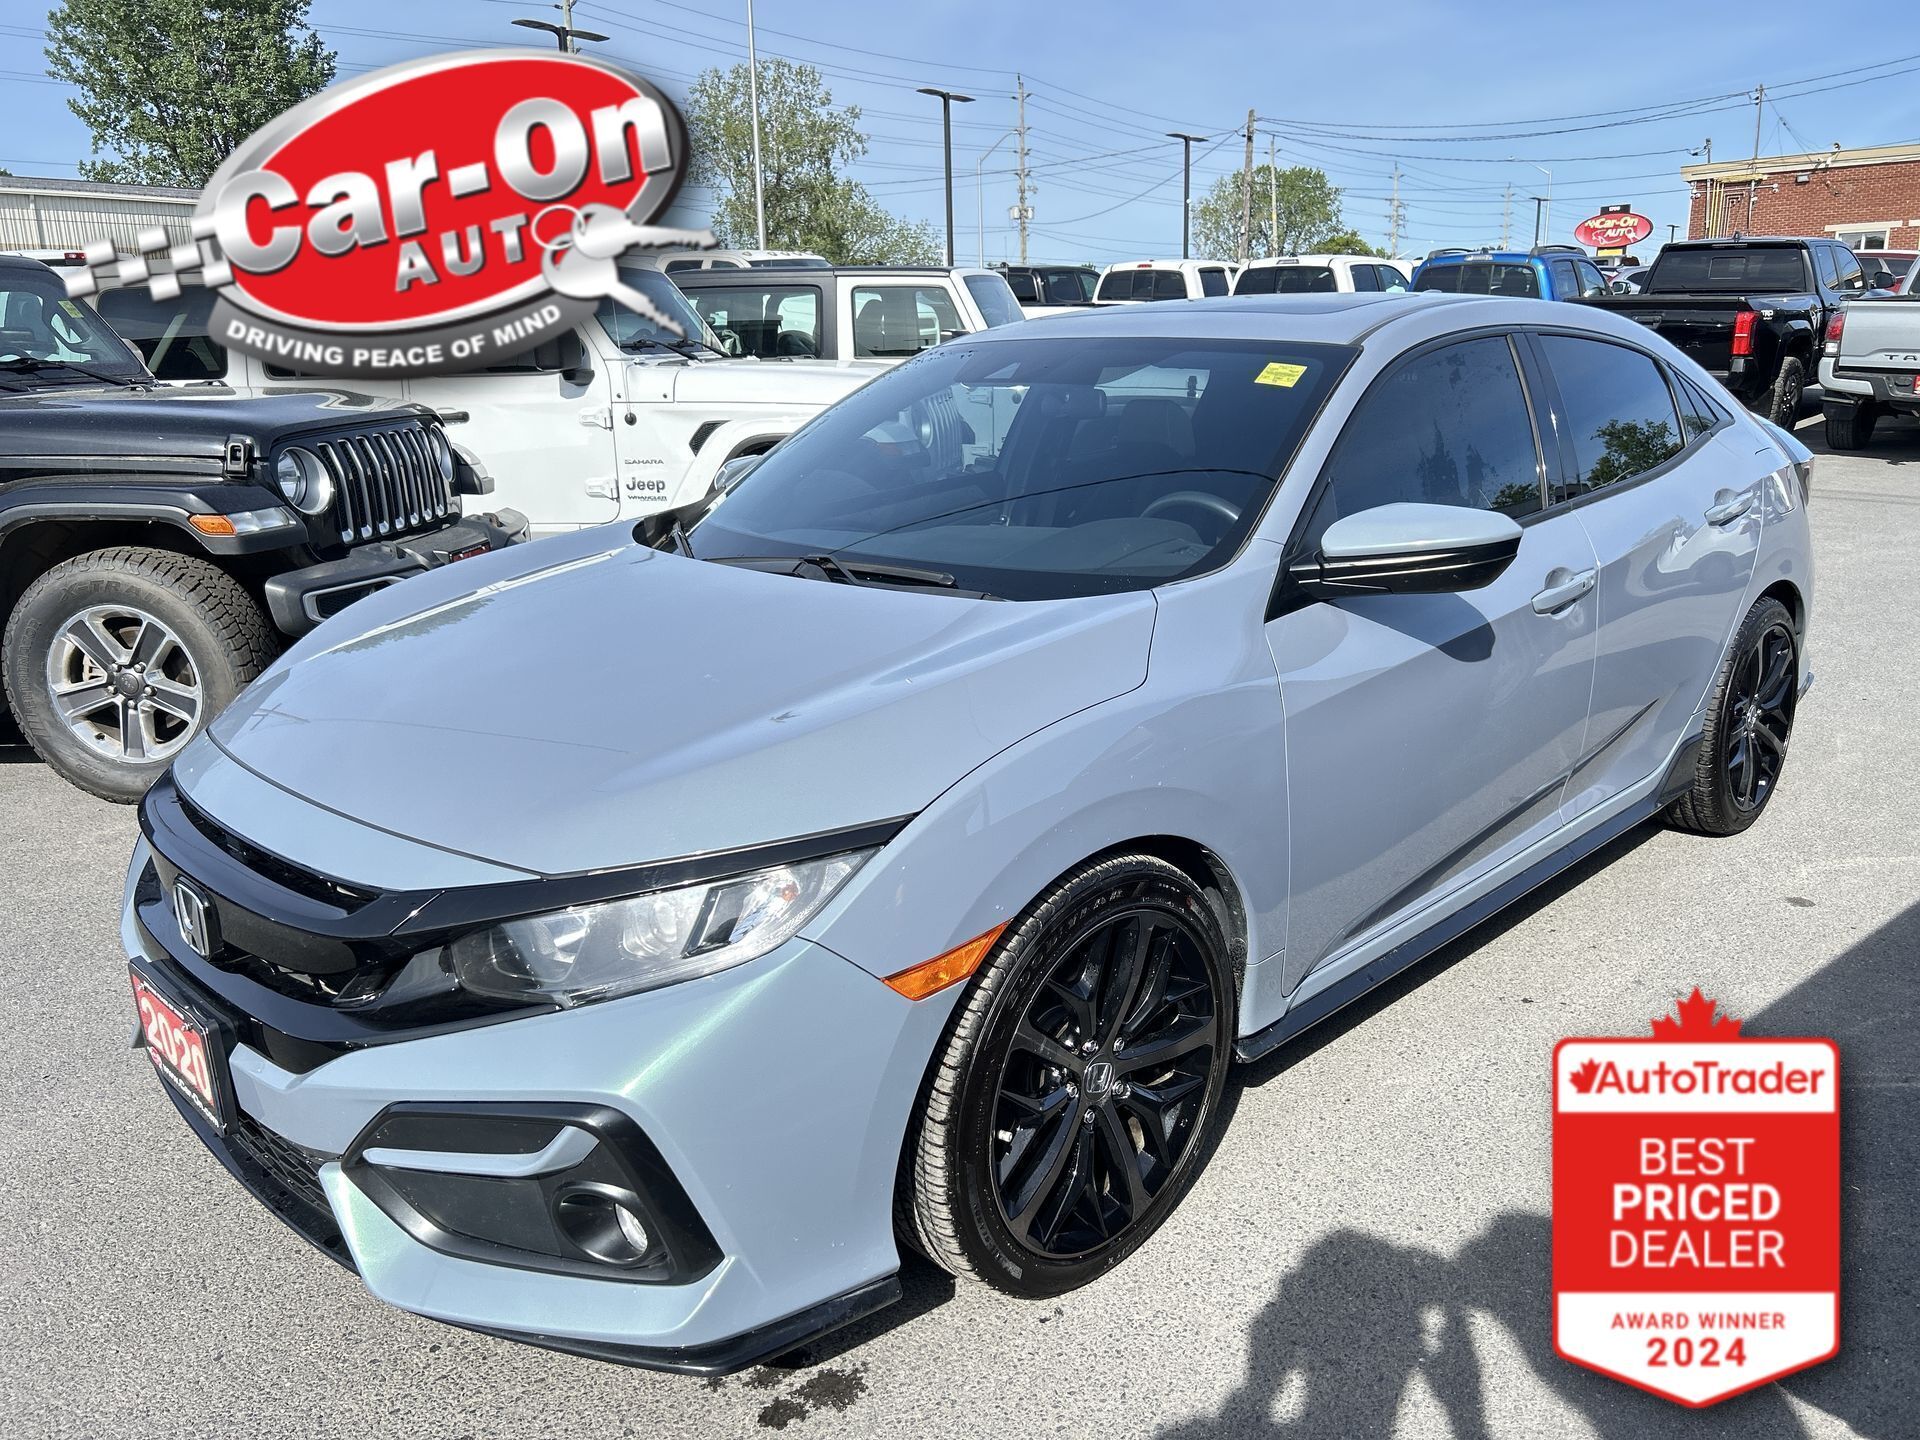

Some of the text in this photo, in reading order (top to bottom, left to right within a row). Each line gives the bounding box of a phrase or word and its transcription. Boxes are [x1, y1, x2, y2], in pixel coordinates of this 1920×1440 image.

[1597, 216, 1638, 229] Car-On
[626, 477, 666, 493] Jeep
[140, 996, 213, 1103] 2020
